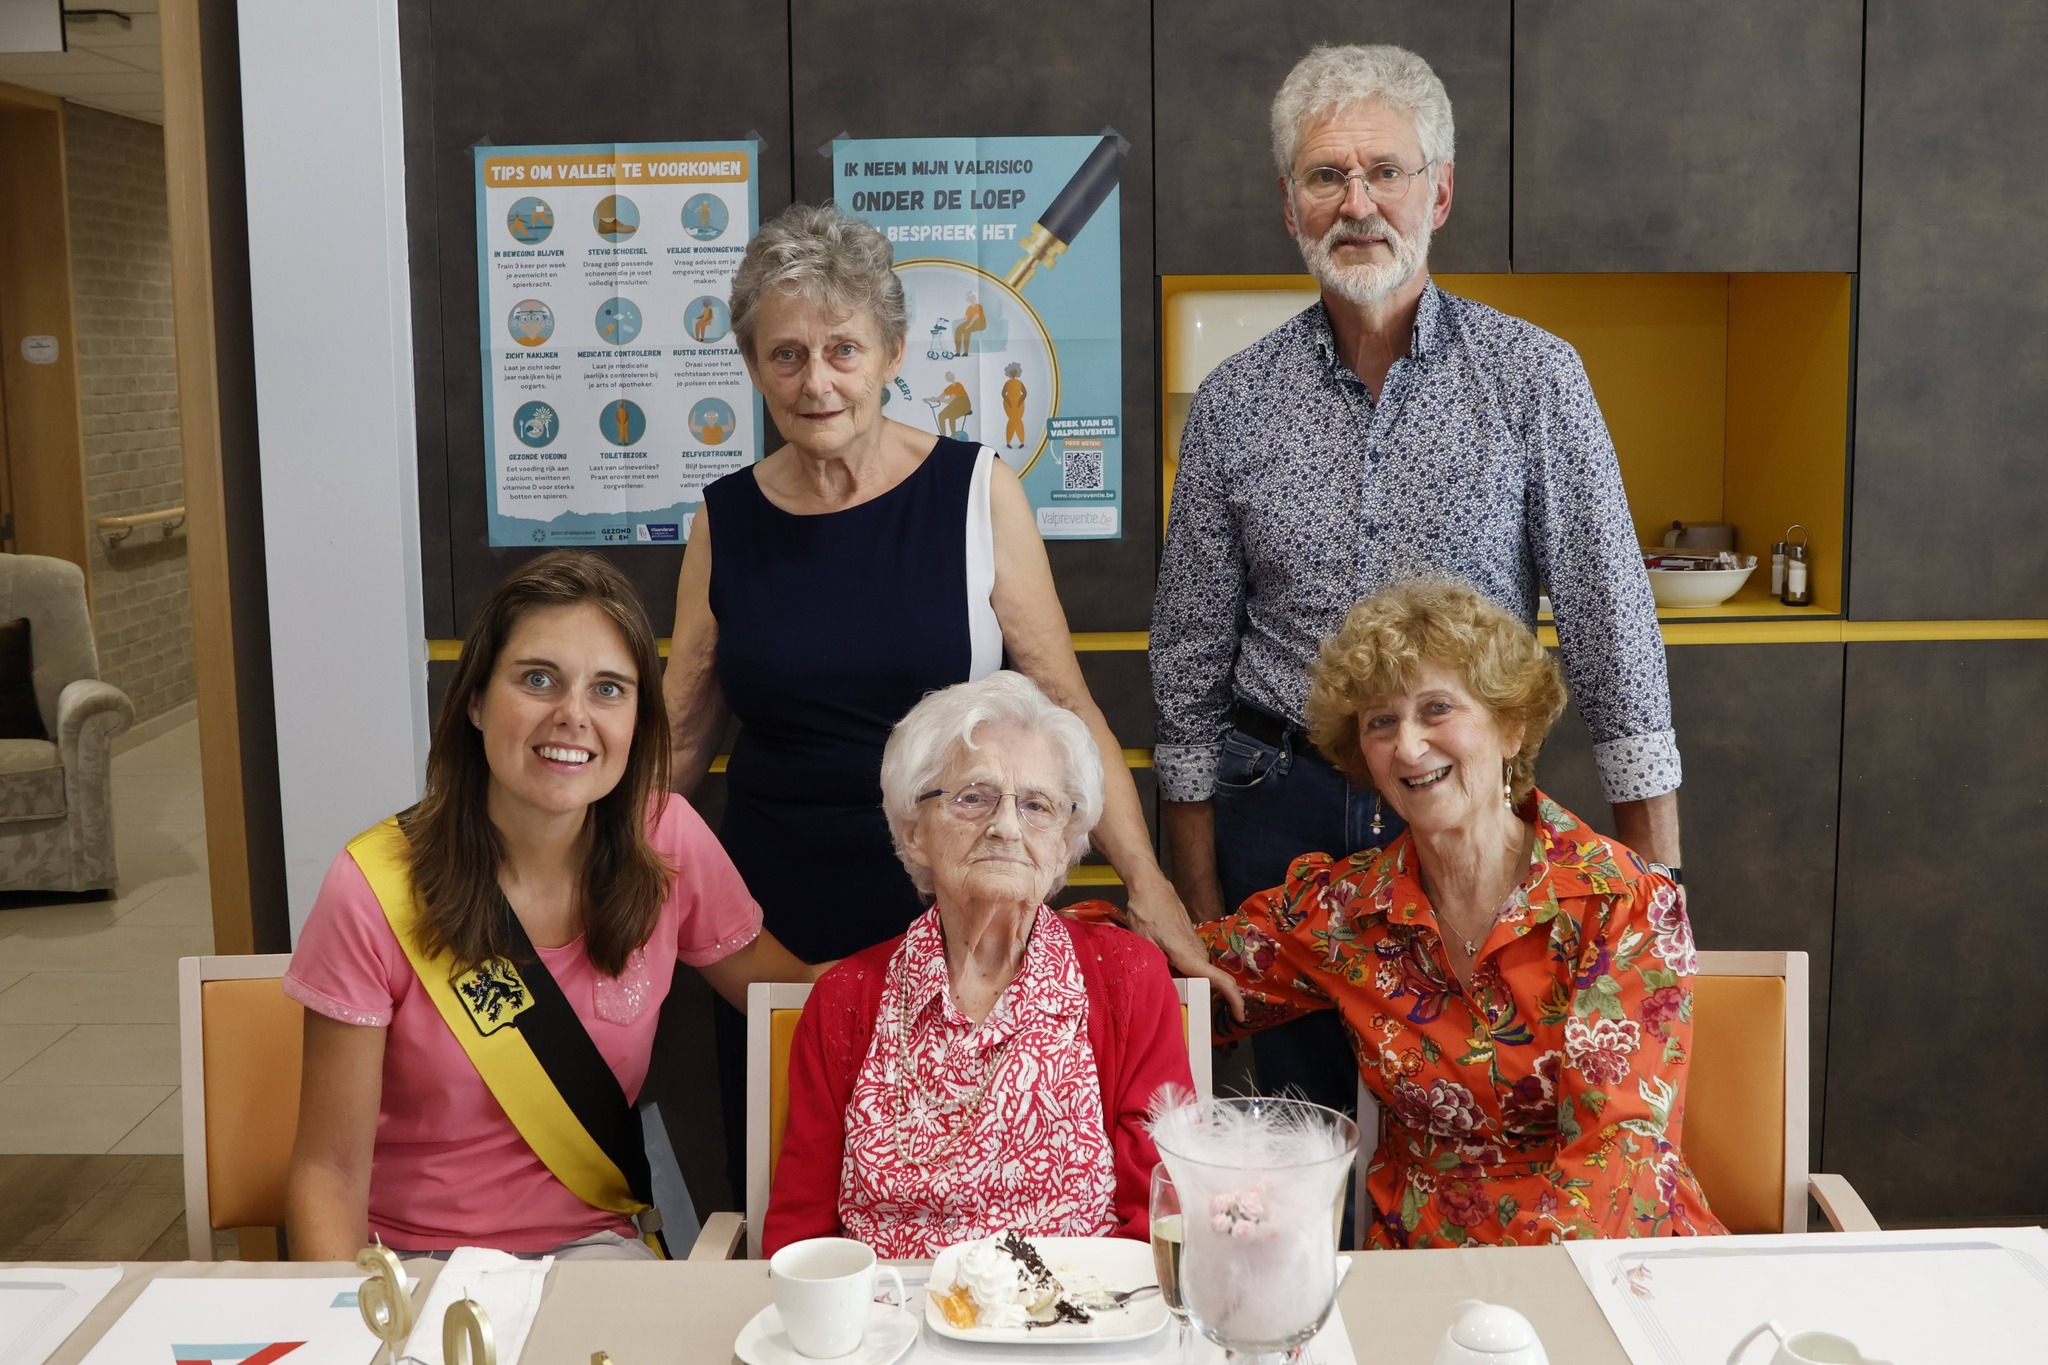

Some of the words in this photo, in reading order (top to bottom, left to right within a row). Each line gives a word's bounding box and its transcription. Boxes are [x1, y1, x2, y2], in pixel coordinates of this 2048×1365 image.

[491, 166, 525, 181] TIPS
[530, 165, 552, 180] OM
[558, 164, 616, 179] VALLEN
[622, 163, 643, 178] TE
[648, 161, 741, 177] VOORKOMEN
[844, 162, 859, 177] IK
[864, 161, 907, 176] NEEM
[912, 161, 949, 175] MIJN
[954, 160, 1033, 175] VALRISICO
[852, 191, 924, 212] ONDER
[934, 190, 962, 210] DE
[971, 189, 1026, 210] LOEP
[888, 224, 977, 242] BESPREEK
[983, 224, 1017, 240] HET
[503, 250, 535, 258] BEWEGING
[693, 246, 745, 254] WOONOMGEVING
[583, 261, 602, 269] Draag
[604, 261, 620, 269] goed
[621, 260, 654, 268] passende
[674, 260, 693, 268] Vraag
[730, 259, 736, 267] je
[506, 272, 513, 280] je
[672, 269, 704, 277] omgeving
[706, 268, 730, 276] veiliger
[513, 281, 553, 289] spierkracht.
[588, 280, 614, 288] volledig
[613, 349, 662, 357] CONTROLEREN
[607, 363, 614, 371] je
[504, 374, 516, 382] jaar
[518, 373, 545, 381] nakijken
[546, 373, 554, 381] bij
[555, 373, 562, 381] je
[583, 372, 608, 380] jaarlijks
[609, 371, 648, 379] controleren
[650, 371, 659, 379] bij
[521, 383, 547, 391] oogarts.
[588, 381, 594, 389] je
[619, 380, 654, 389] apotheker.
[676, 379, 683, 387] je
[684, 379, 706, 387] polsen
[1052, 420, 1079, 428] WEEK
[1050, 428, 1116, 437] VALPREVENTIE
[682, 450, 743, 458] ZELFVERTROUWEN
[519, 465, 544, 474] voeding
[546, 465, 557, 473] rijk
[543, 493, 569, 501] spieren.
[1053, 492, 1114, 501] www.valpreventie.be
[1041, 512, 1112, 527] Valpreventie.be
